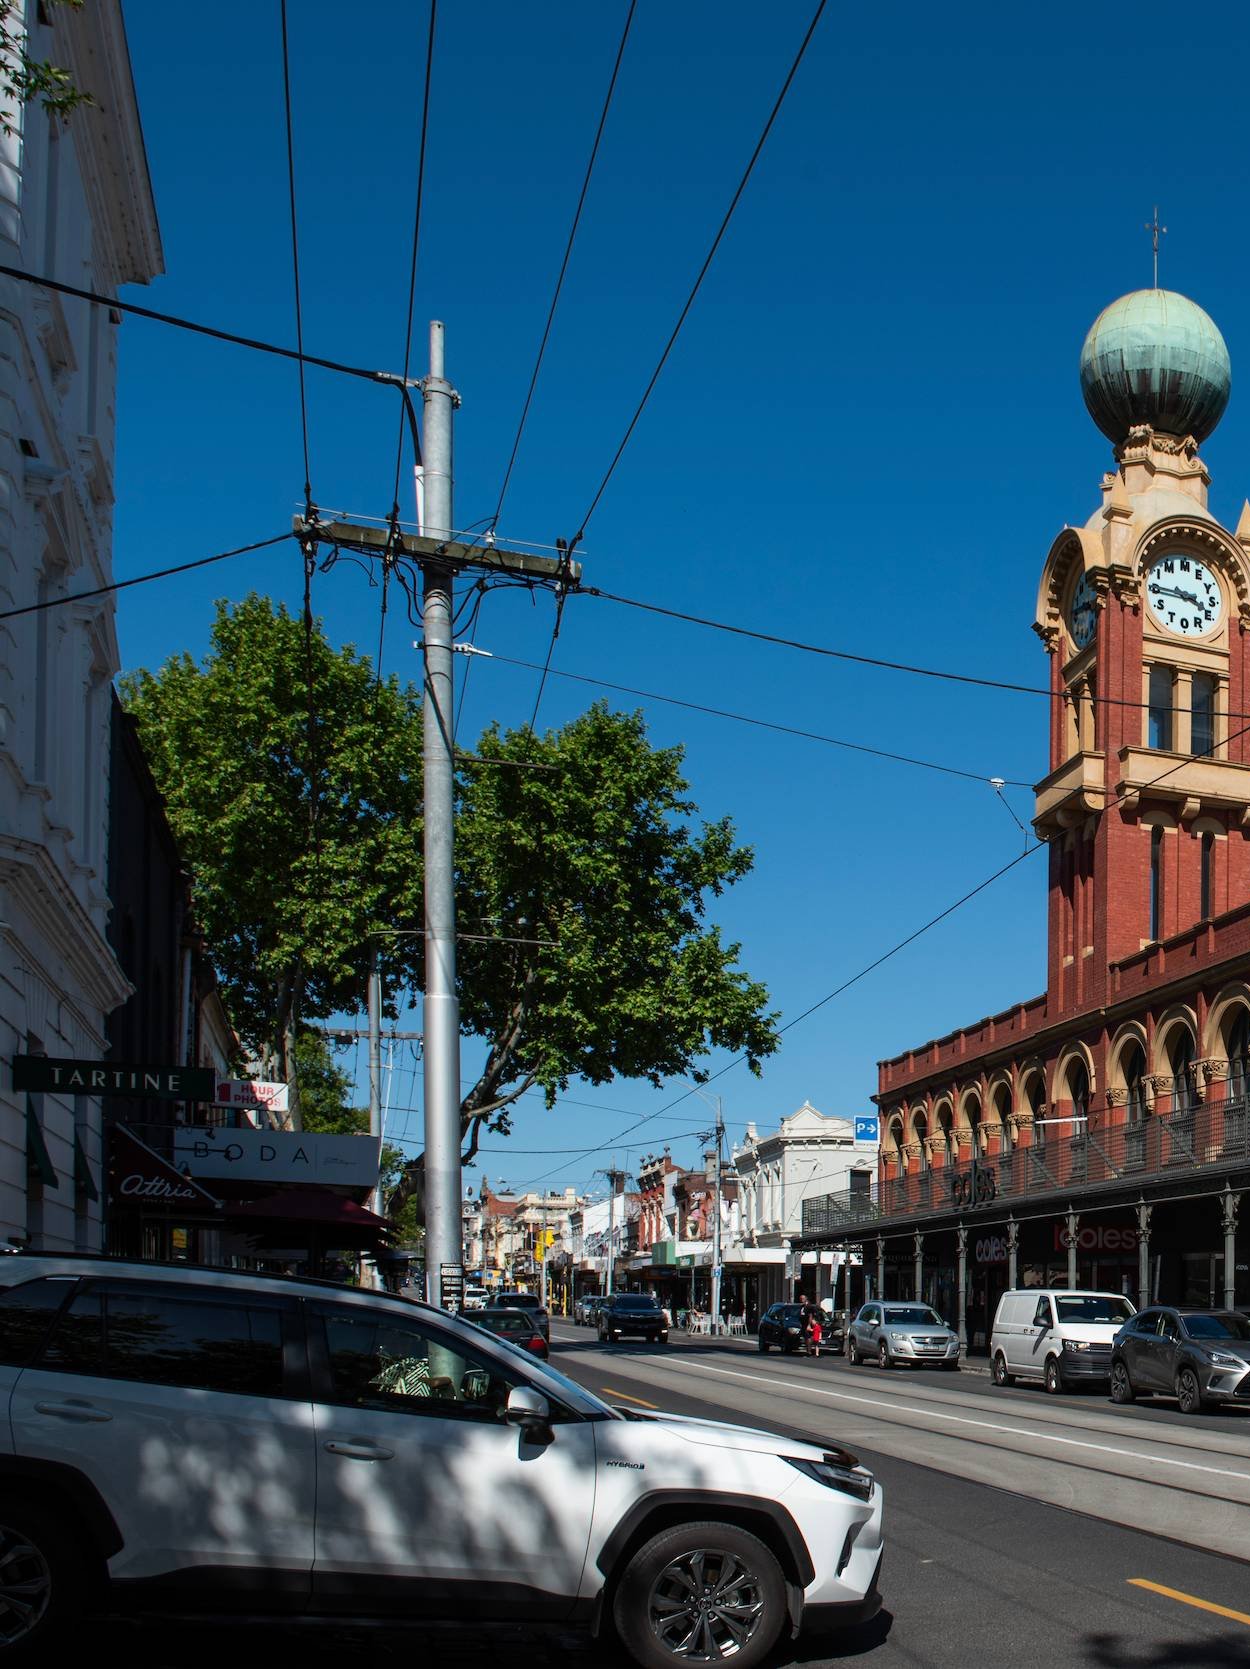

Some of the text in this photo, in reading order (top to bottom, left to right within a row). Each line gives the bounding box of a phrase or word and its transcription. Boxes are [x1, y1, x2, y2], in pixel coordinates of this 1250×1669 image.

[51, 1067, 181, 1092] TARTINE
[241, 1084, 274, 1096] HOUR
[234, 1094, 281, 1107] PHOTOS
[194, 1141, 309, 1164] BODA
[951, 1159, 995, 1206] coles
[975, 1234, 1009, 1263] coles
